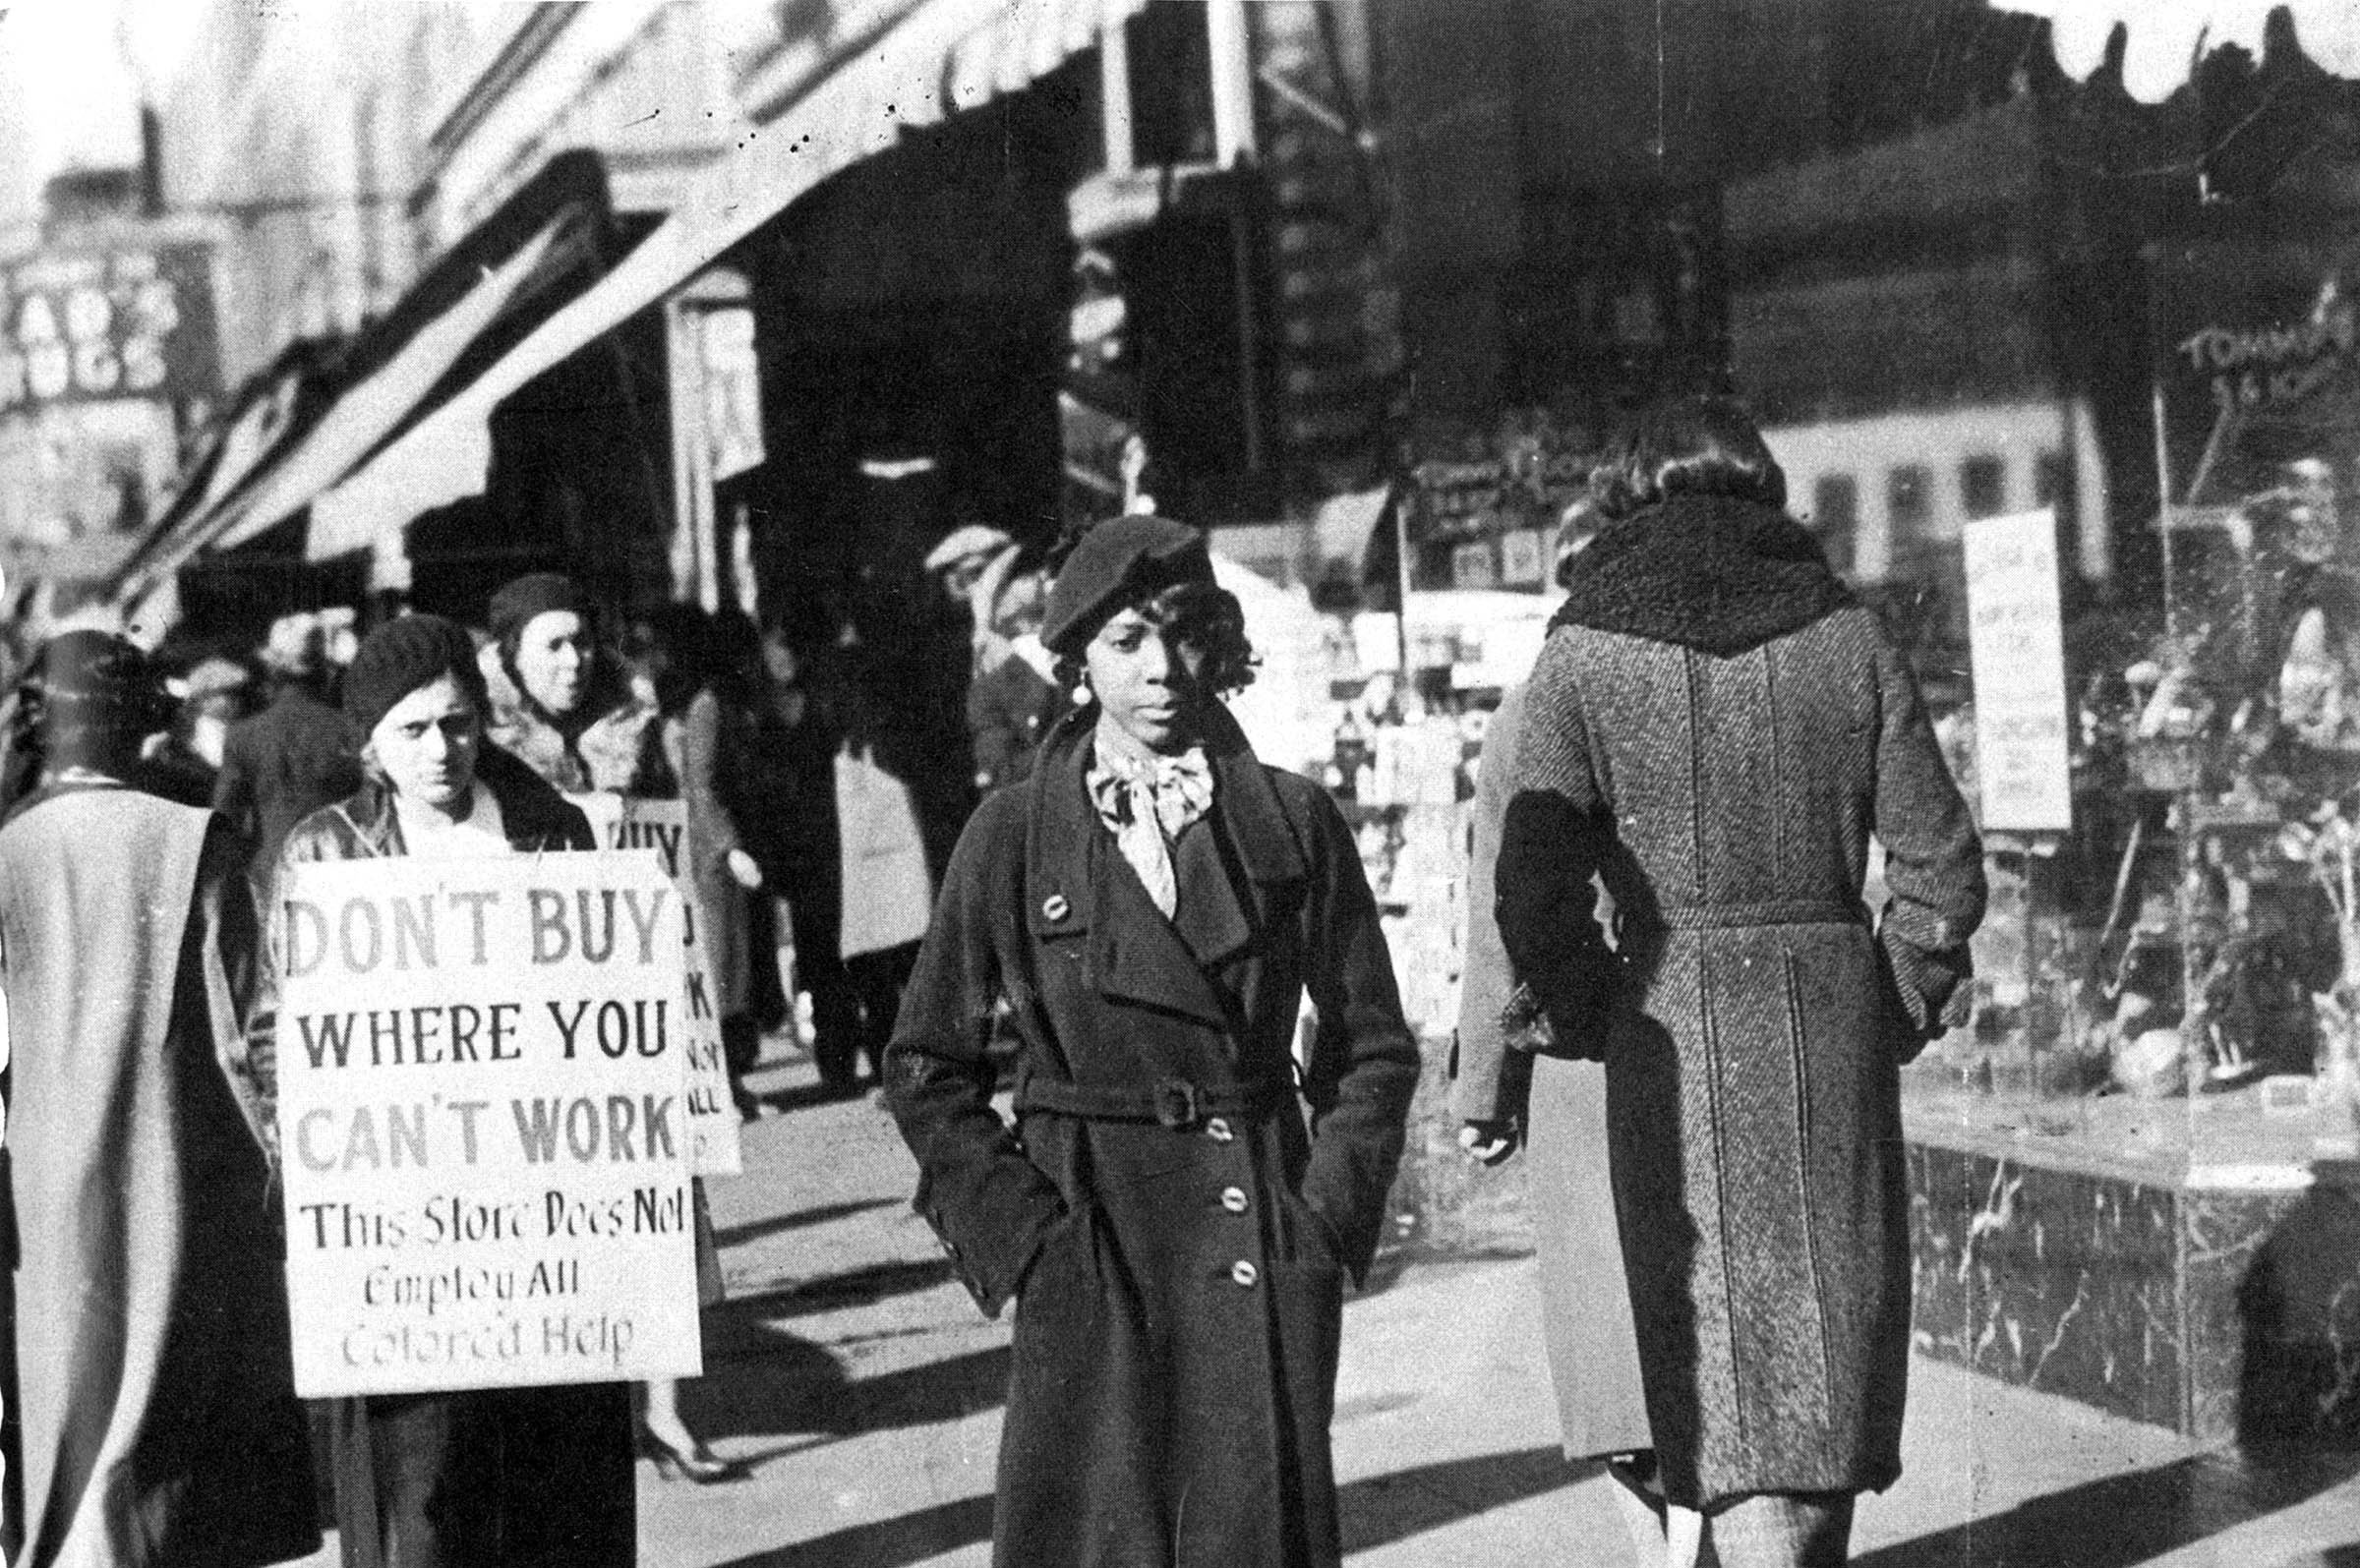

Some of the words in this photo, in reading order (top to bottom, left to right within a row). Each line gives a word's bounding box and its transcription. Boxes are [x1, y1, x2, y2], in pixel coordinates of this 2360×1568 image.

[283, 882, 501, 977] DON'T
[528, 888, 670, 966] BUY
[295, 1003, 522, 1069] WHERE
[547, 1000, 668, 1061] YOU
[296, 1092, 492, 1173] CAN'T
[510, 1092, 677, 1165] WORK
[299, 1200, 405, 1249] This
[425, 1195, 530, 1245] Store
[544, 1190, 623, 1239] Does
[633, 1187, 684, 1234] Not
[364, 1262, 515, 1316] Employ
[527, 1258, 578, 1298] All
[543, 1314, 634, 1367] Help
